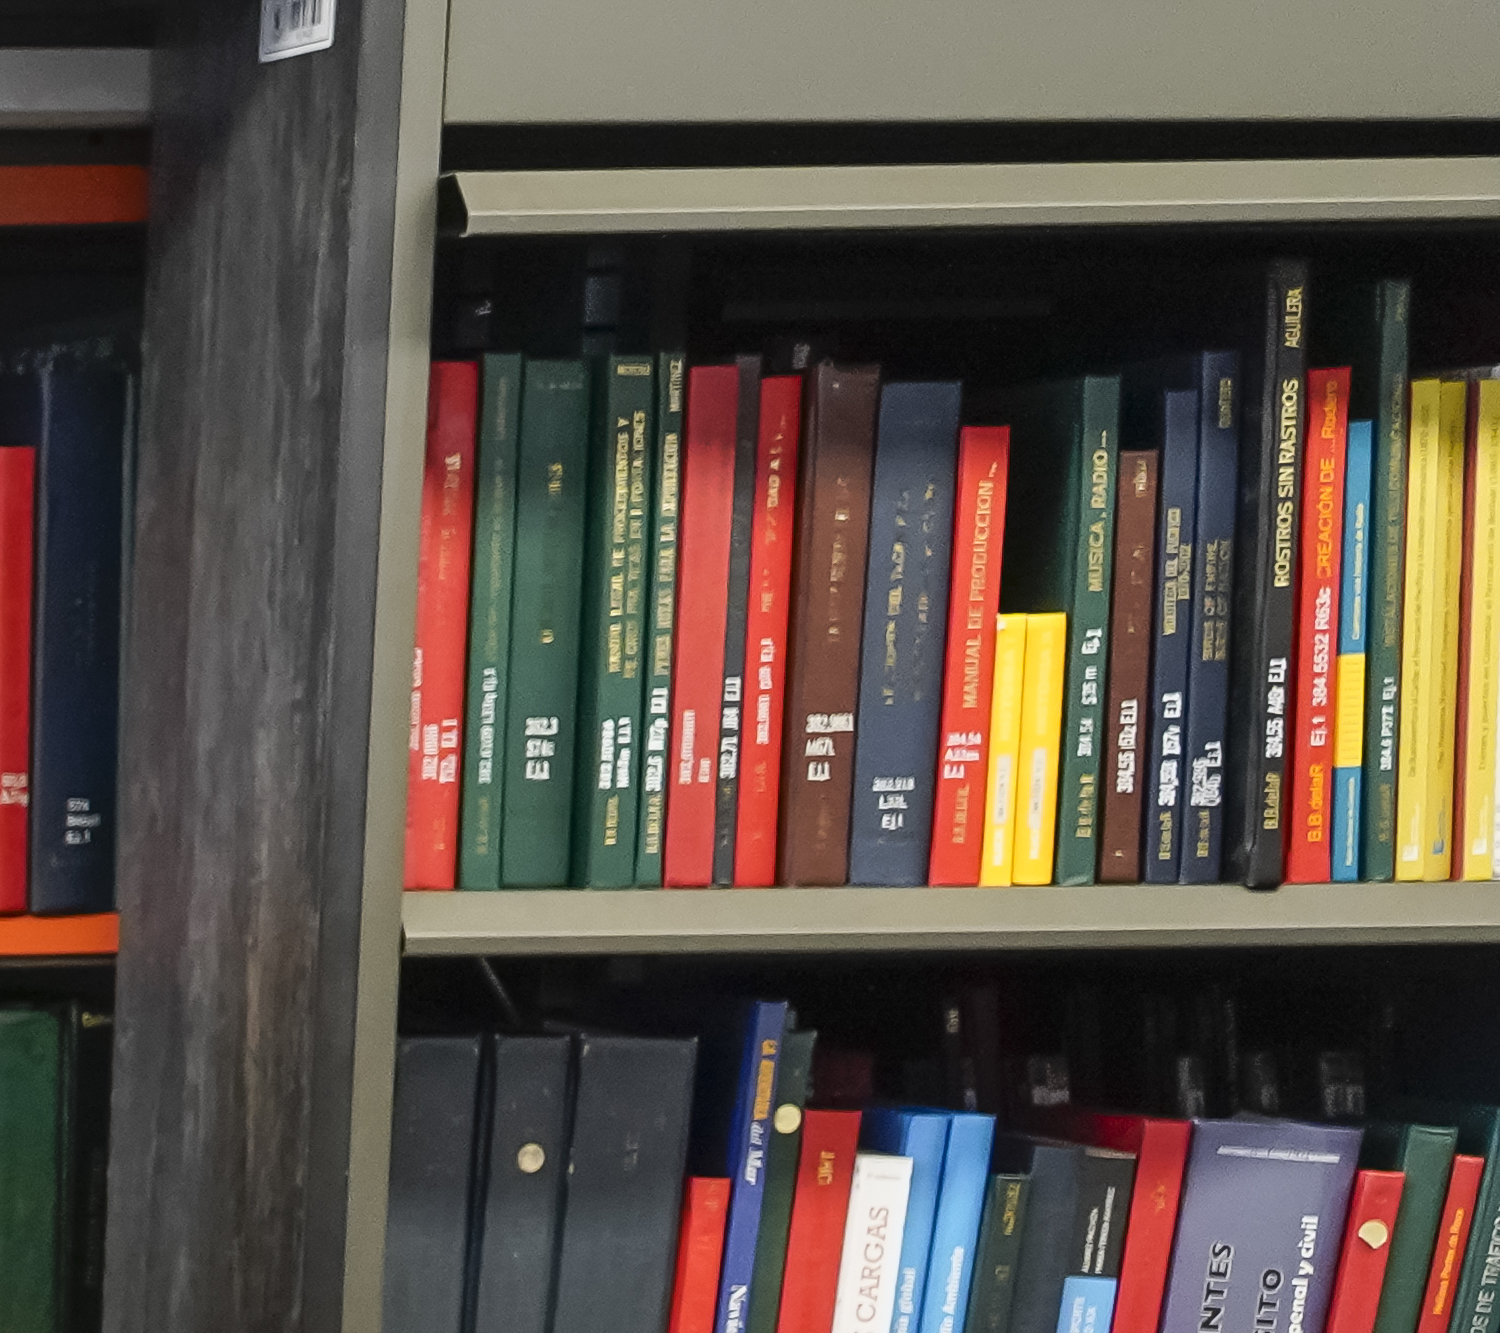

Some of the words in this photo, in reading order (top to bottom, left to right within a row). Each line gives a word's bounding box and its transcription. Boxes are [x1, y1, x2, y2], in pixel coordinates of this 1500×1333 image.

[1284, 289, 1303, 347] AGUILERA
[1277, 379, 1299, 464] RASTROS
[1276, 466, 1295, 497] SIN
[970, 480, 993, 601] PRODUCCION
[1273, 501, 1294, 587] ROSTROS
[966, 606, 985, 629] DE
[961, 635, 982, 708] MANUAL
[855, 1206, 890, 1321] CARGAS
[1297, 1215, 1319, 1258] civil
